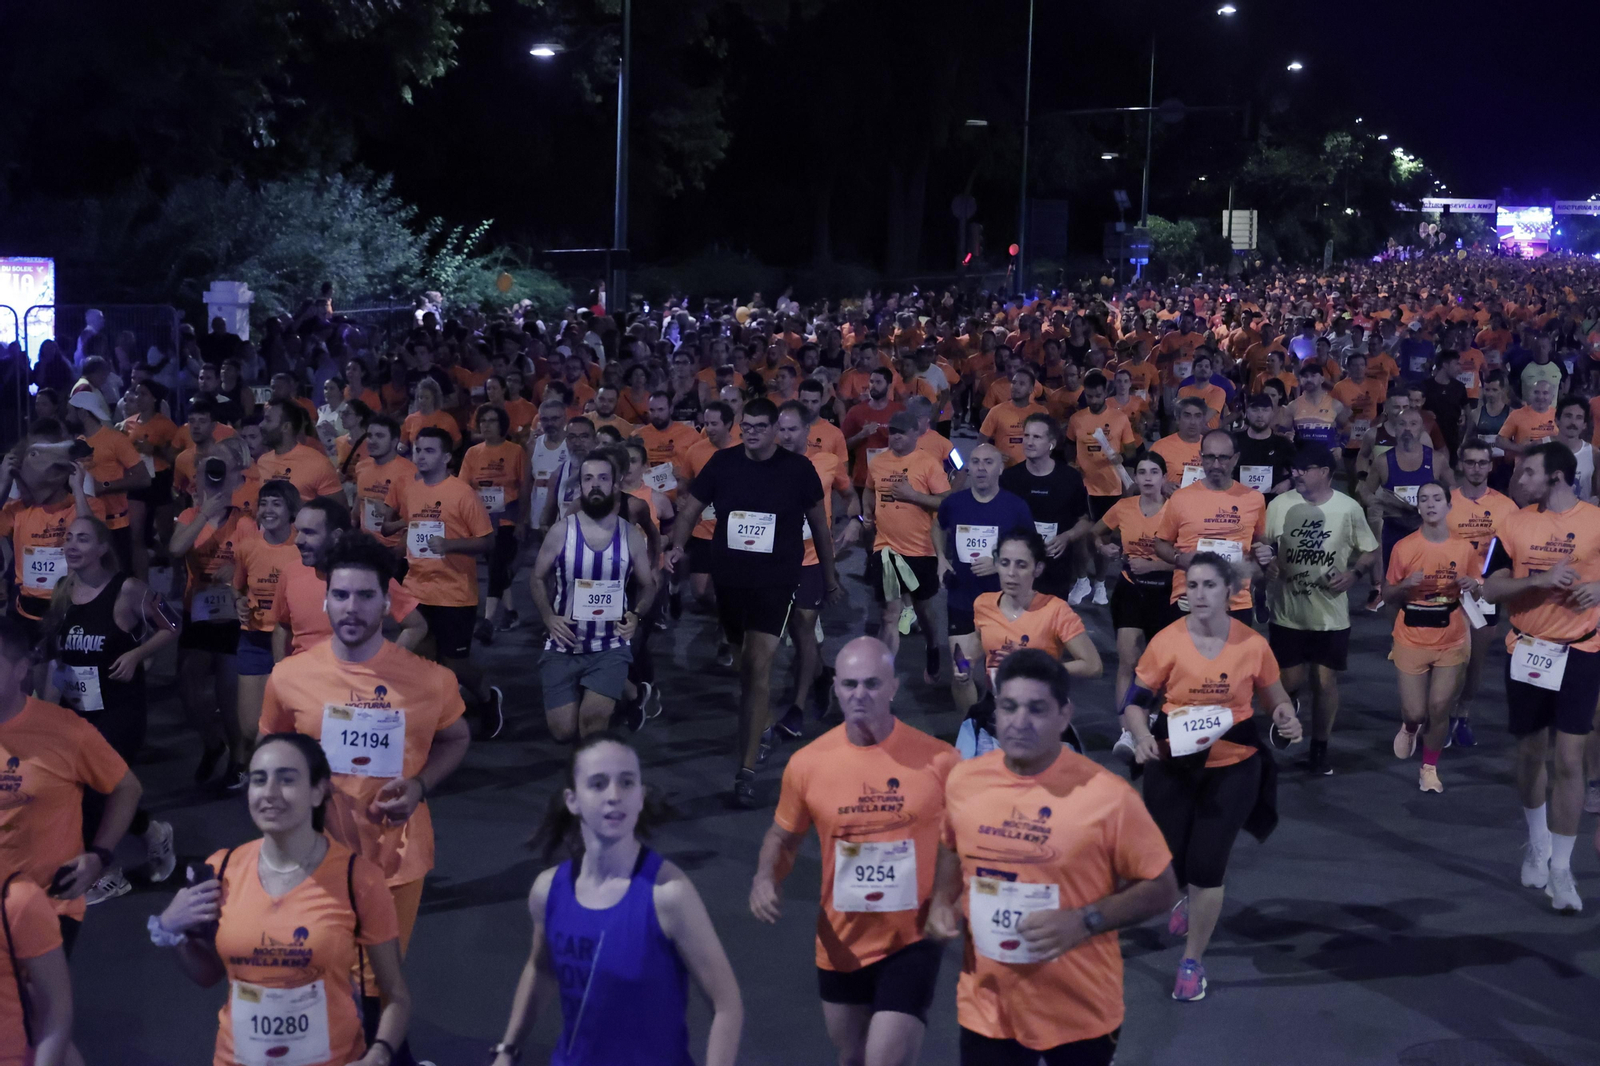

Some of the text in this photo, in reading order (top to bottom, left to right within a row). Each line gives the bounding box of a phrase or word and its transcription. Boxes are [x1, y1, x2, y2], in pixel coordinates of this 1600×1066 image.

[652, 472, 668, 483] 7059
[1302, 518, 1324, 528] LAS
[737, 523, 766, 536] 21727
[1290, 528, 1333, 540] CHICAS
[966, 537, 987, 548] 2615
[1297, 539, 1324, 549] SON
[1529, 544, 1574, 555] SEVILLA KH7
[1286, 548, 1337, 567] GUERRERAS
[31, 561, 55, 572] 4312
[204, 595, 226, 604] 4211
[588, 594, 612, 605] 3978
[64, 635, 105, 654] ATAQUE
[1526, 652, 1553, 669] 7079
[1182, 716, 1222, 732] 12254
[340, 730, 390, 749] 12194
[858, 795, 904, 803] NOCTURNA
[838, 803, 904, 815] SEVILLA KH7
[1002, 819, 1051, 834] NOCTURNA
[978, 825, 1049, 845] SEVILLA KH7
[855, 865, 895, 882] 9254
[253, 947, 313, 957] NOCTURNA
[229, 956, 311, 968] SEVILLA KH7
[250, 1013, 309, 1036] 10280
